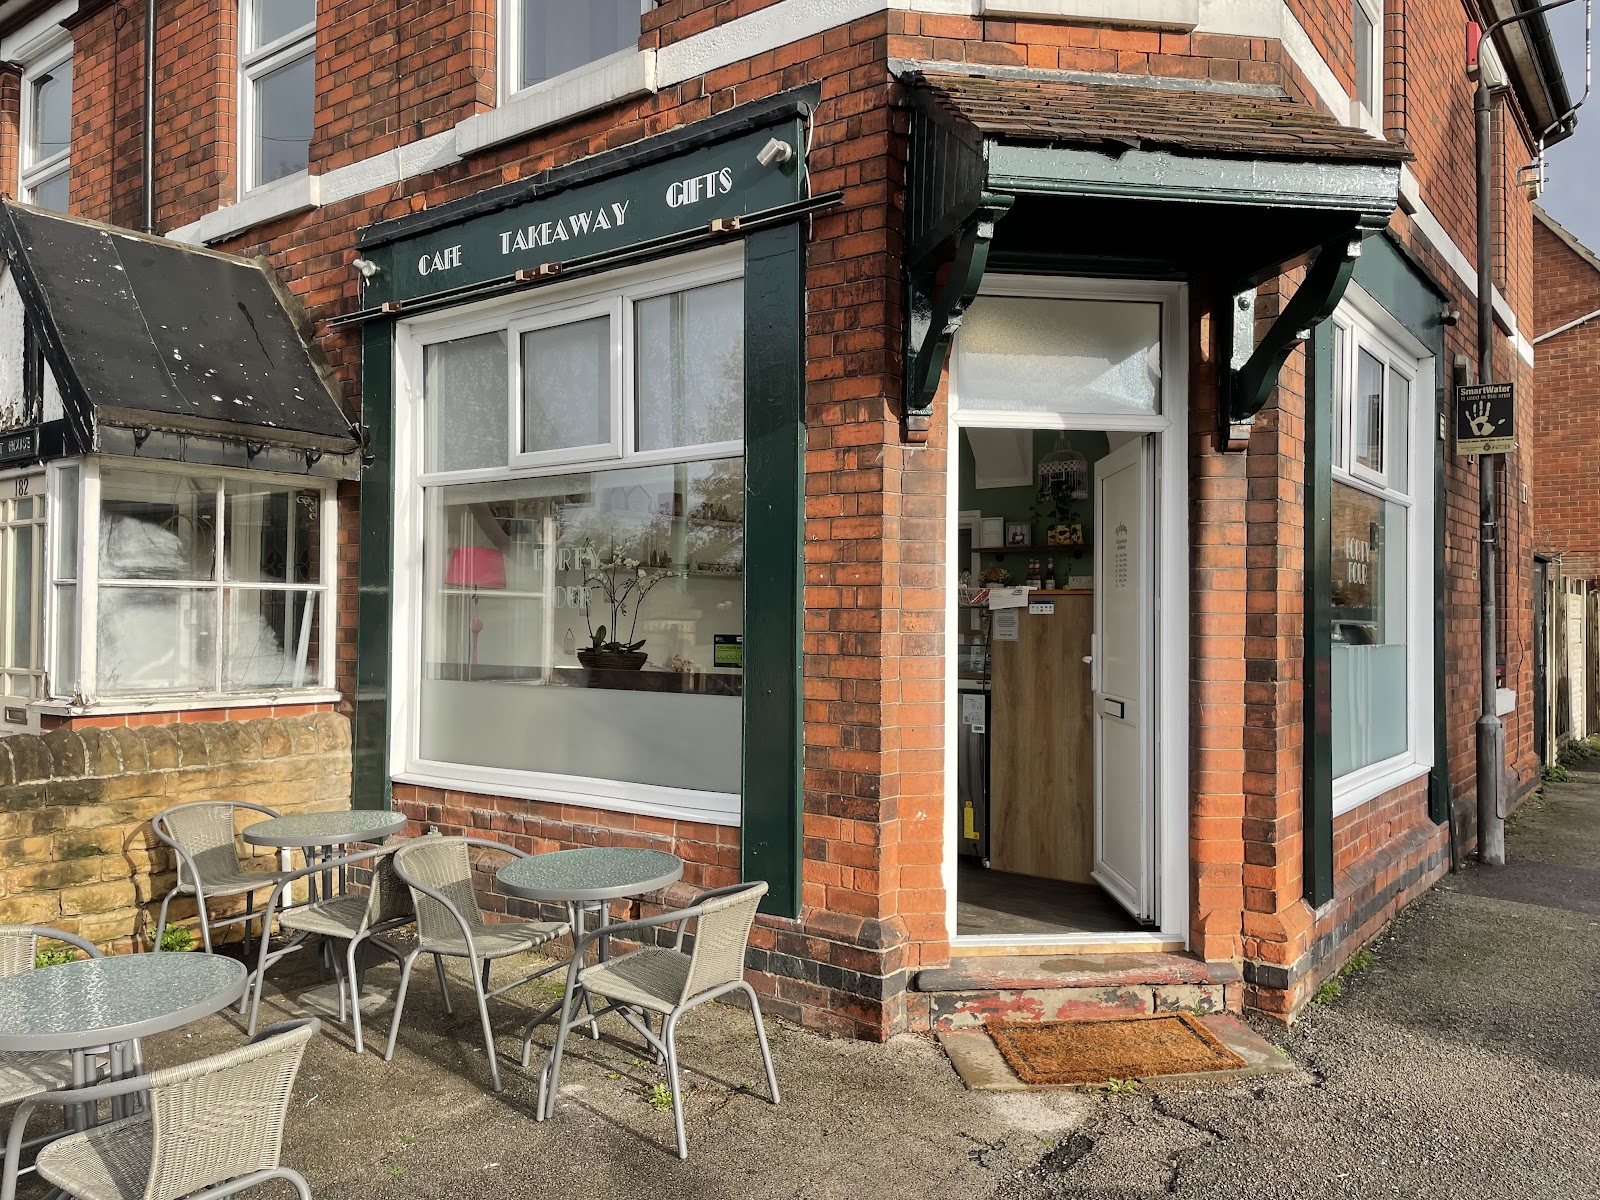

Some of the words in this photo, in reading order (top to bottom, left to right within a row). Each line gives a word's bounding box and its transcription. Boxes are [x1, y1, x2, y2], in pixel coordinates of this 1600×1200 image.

[418, 245, 462, 276] CAFE
[500, 200, 630, 255] TAKEAWAY
[665, 167, 733, 208] GIFTS
[1461, 385, 1511, 396] SmartWater
[15, 478, 29, 497] 182
[533, 546, 601, 571] FORTY
[1346, 537, 1370, 563] FORTY
[1348, 561, 1368, 585] FOUR
[551, 586, 593, 609] OUR
